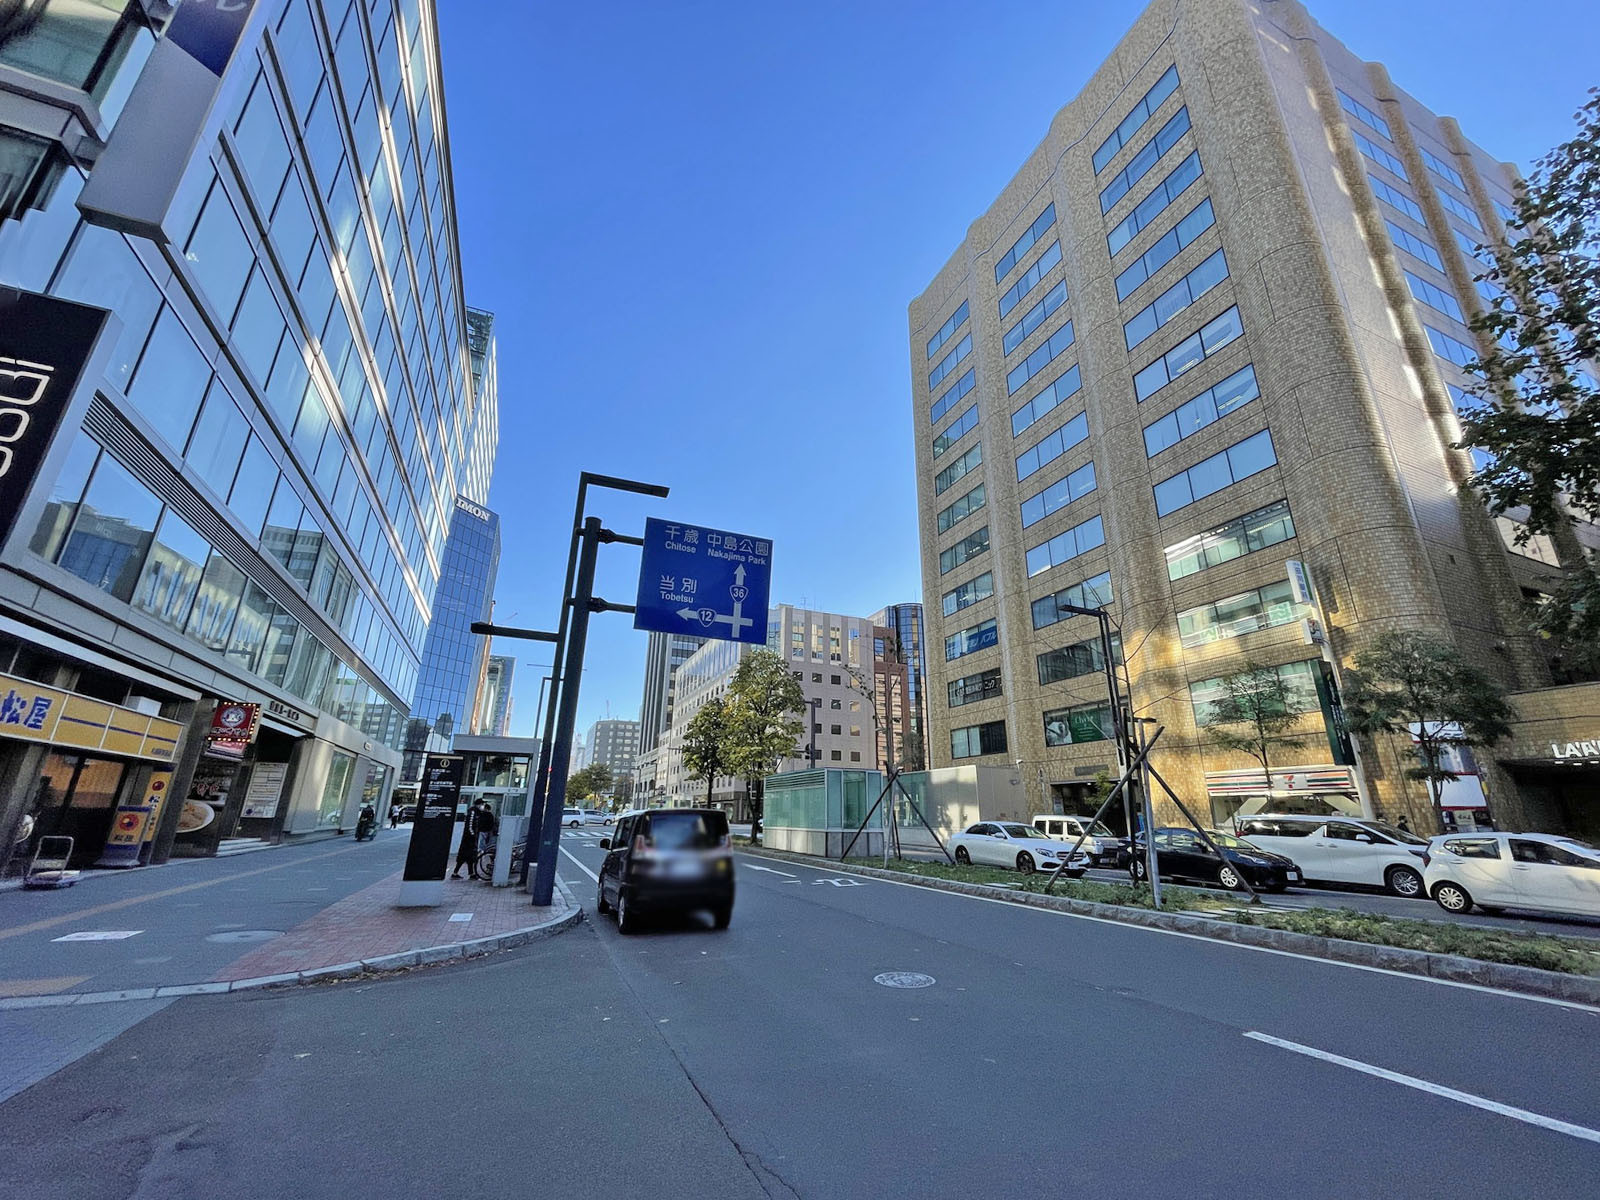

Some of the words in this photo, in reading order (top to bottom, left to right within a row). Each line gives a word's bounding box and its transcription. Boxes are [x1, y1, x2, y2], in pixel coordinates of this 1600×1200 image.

[665, 525, 699, 545] 千歳
[665, 540, 697, 554] Chitose
[707, 533, 769, 556] 中島公園
[708, 548, 746, 562] Nakajima
[748, 555, 767, 566] Park
[660, 575, 697, 594] 当別
[733, 587, 744, 598] 36
[660, 590, 694, 604] Tobetsu
[701, 611, 712, 622] 12
[0, 690, 53, 730] 松屋
